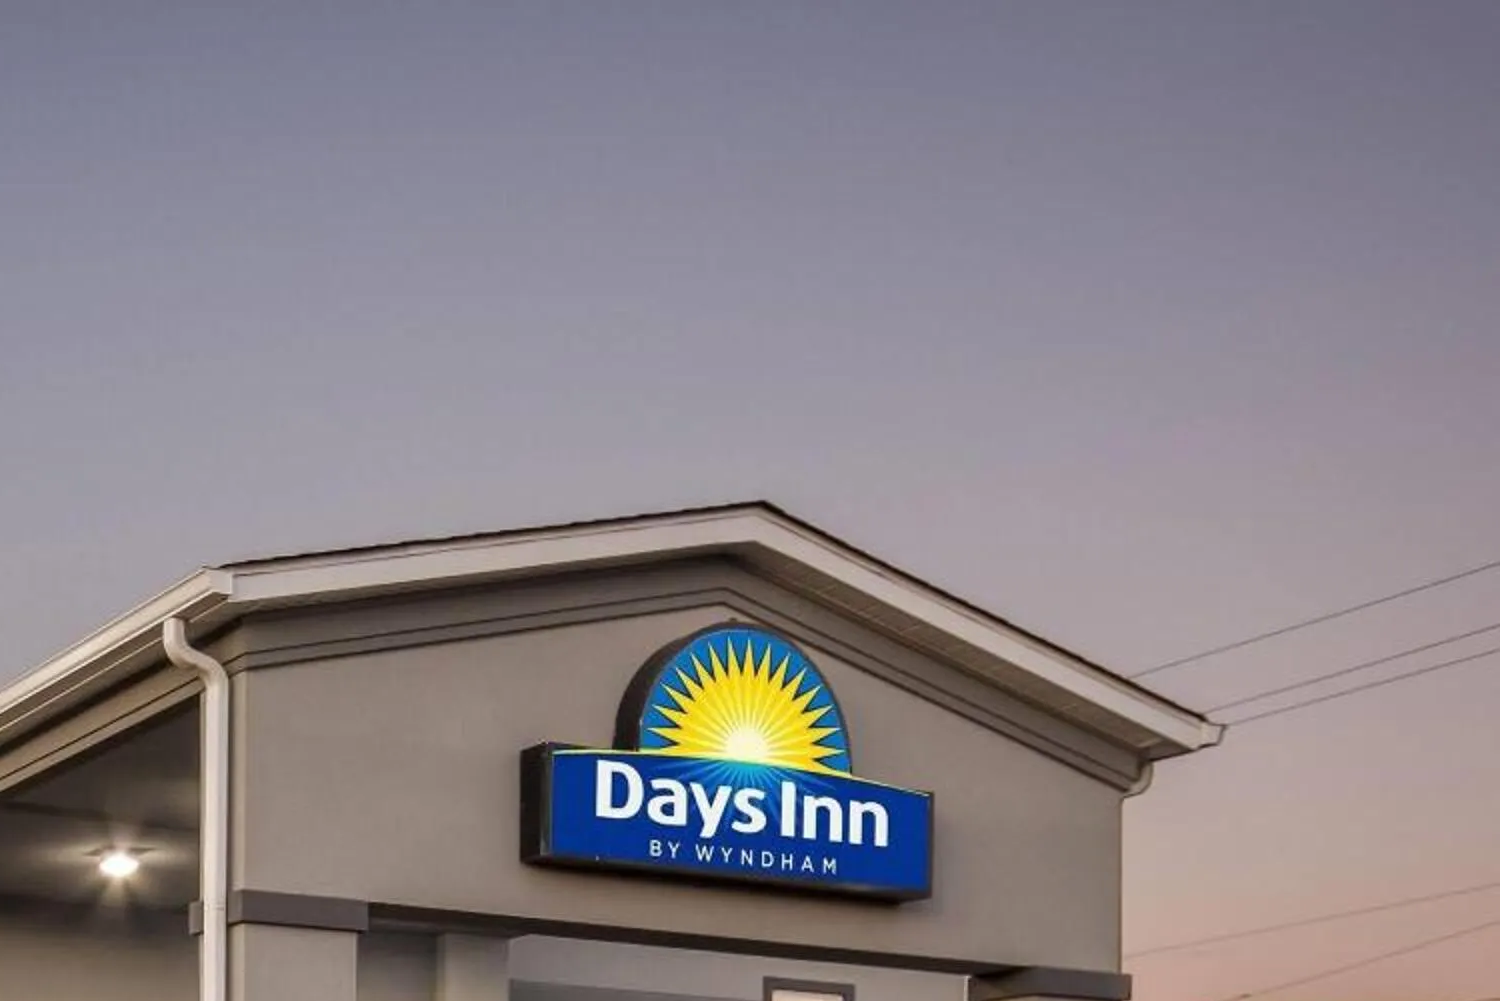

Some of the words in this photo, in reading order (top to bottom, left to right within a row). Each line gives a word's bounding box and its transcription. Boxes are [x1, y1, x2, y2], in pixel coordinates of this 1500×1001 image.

[596, 760, 767, 838] Days
[781, 781, 889, 847] Inn
[650, 839, 680, 859] BY
[695, 843, 837, 875] WYNDHAM
